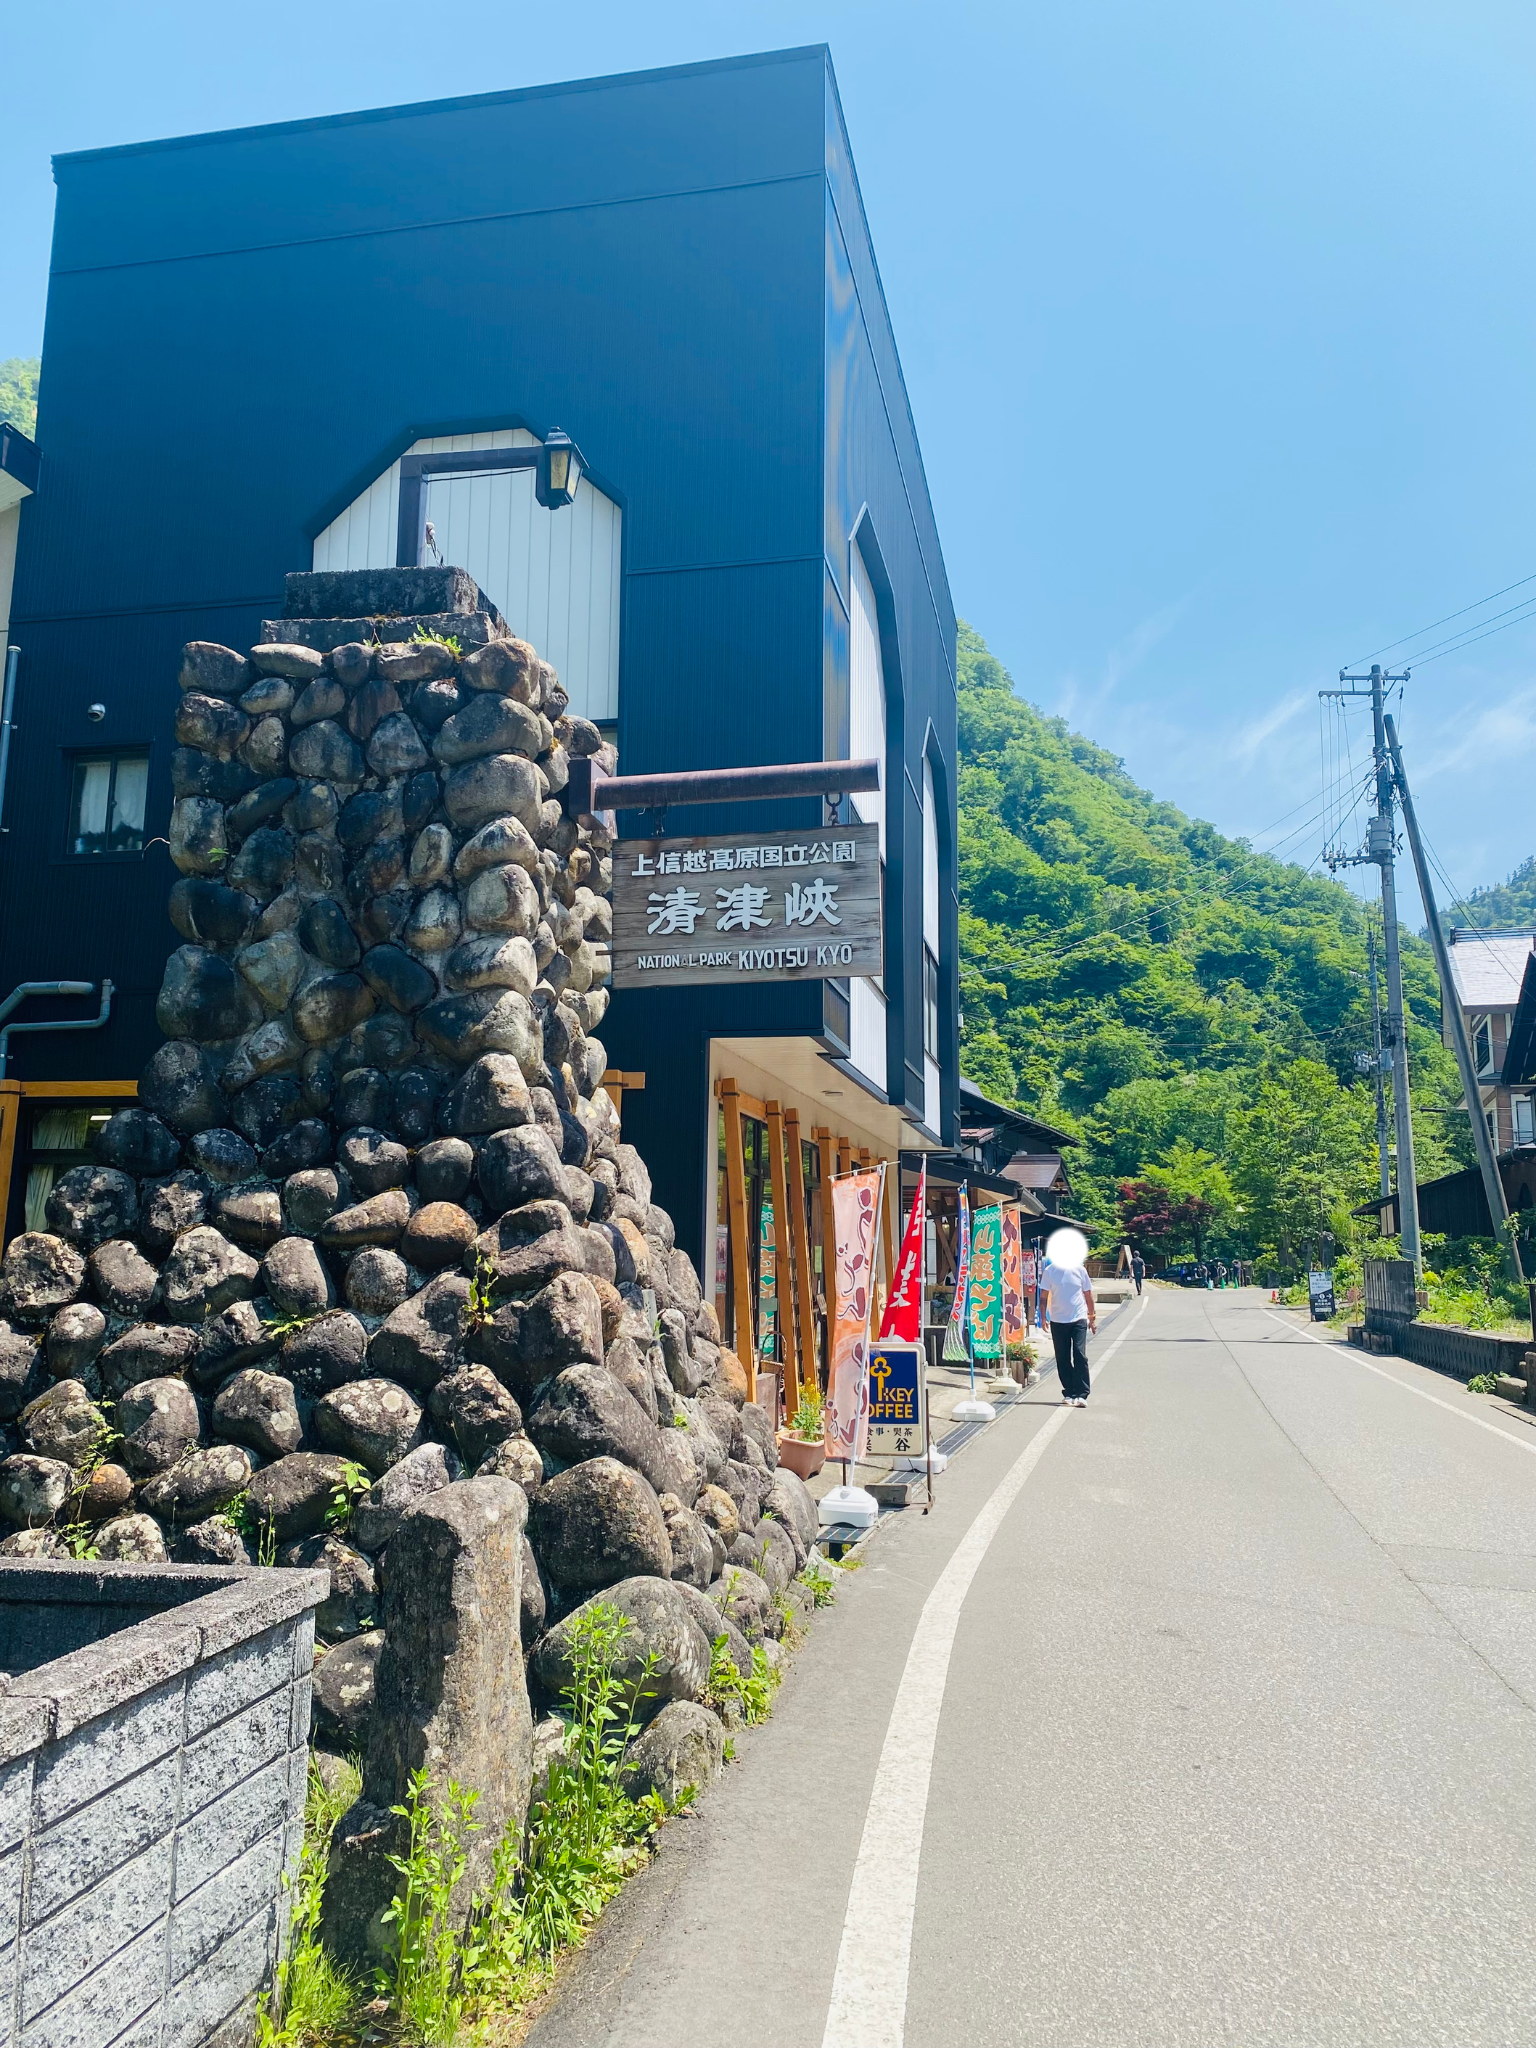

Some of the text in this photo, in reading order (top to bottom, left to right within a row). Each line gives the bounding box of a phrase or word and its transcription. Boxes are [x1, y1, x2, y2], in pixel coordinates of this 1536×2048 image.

[699, 951, 732, 967] PARK
[738, 947, 808, 970] KIYOTSU
[883, 1387, 914, 1402] KEY
[868, 1403, 914, 1418] OFFEE
